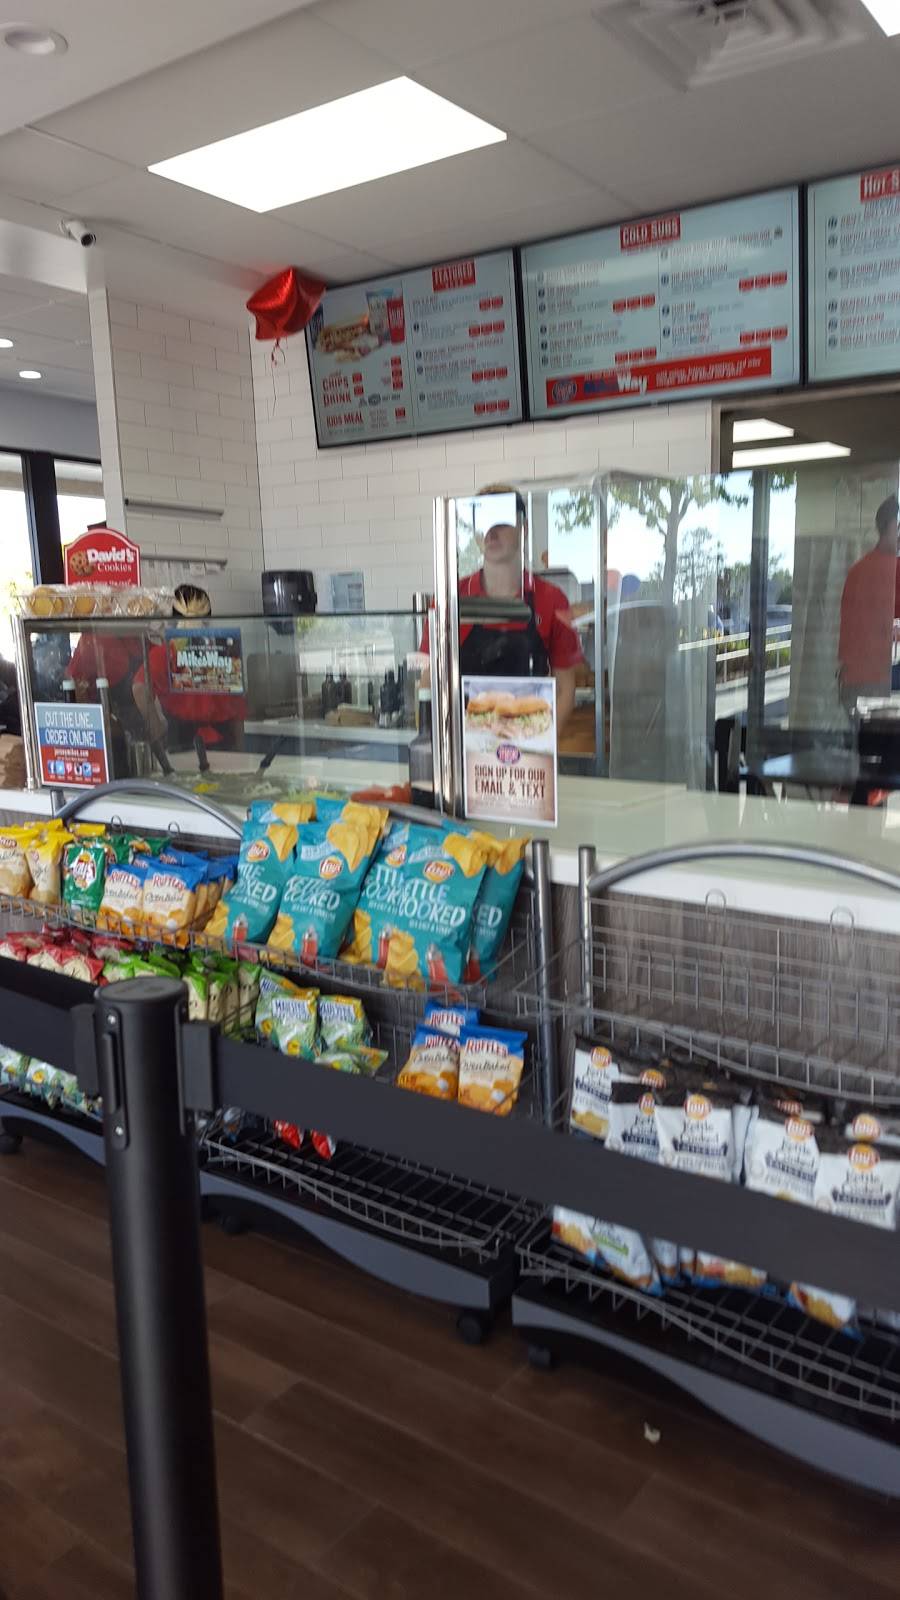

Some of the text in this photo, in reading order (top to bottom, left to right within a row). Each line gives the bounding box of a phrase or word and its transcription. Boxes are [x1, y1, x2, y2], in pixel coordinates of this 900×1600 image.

[622, 227, 648, 243] COLD
[87, 546, 135, 563] David's
[97, 563, 132, 573] Cookies
[45, 711, 94, 729] CUT THE LINE.
[45, 728, 97, 748] ORDER ONLINE!
[474, 765, 546, 782] SIGN UP FOR OUR
[474, 779, 546, 798] EMAIL & TEXT
[320, 859, 342, 874] Lay's
[153, 872, 187, 892] RUFFLES
[399, 897, 467, 928] COOKED
[431, 1011, 466, 1026] RUFFLES
[465, 1037, 509, 1058] RUFFLES
